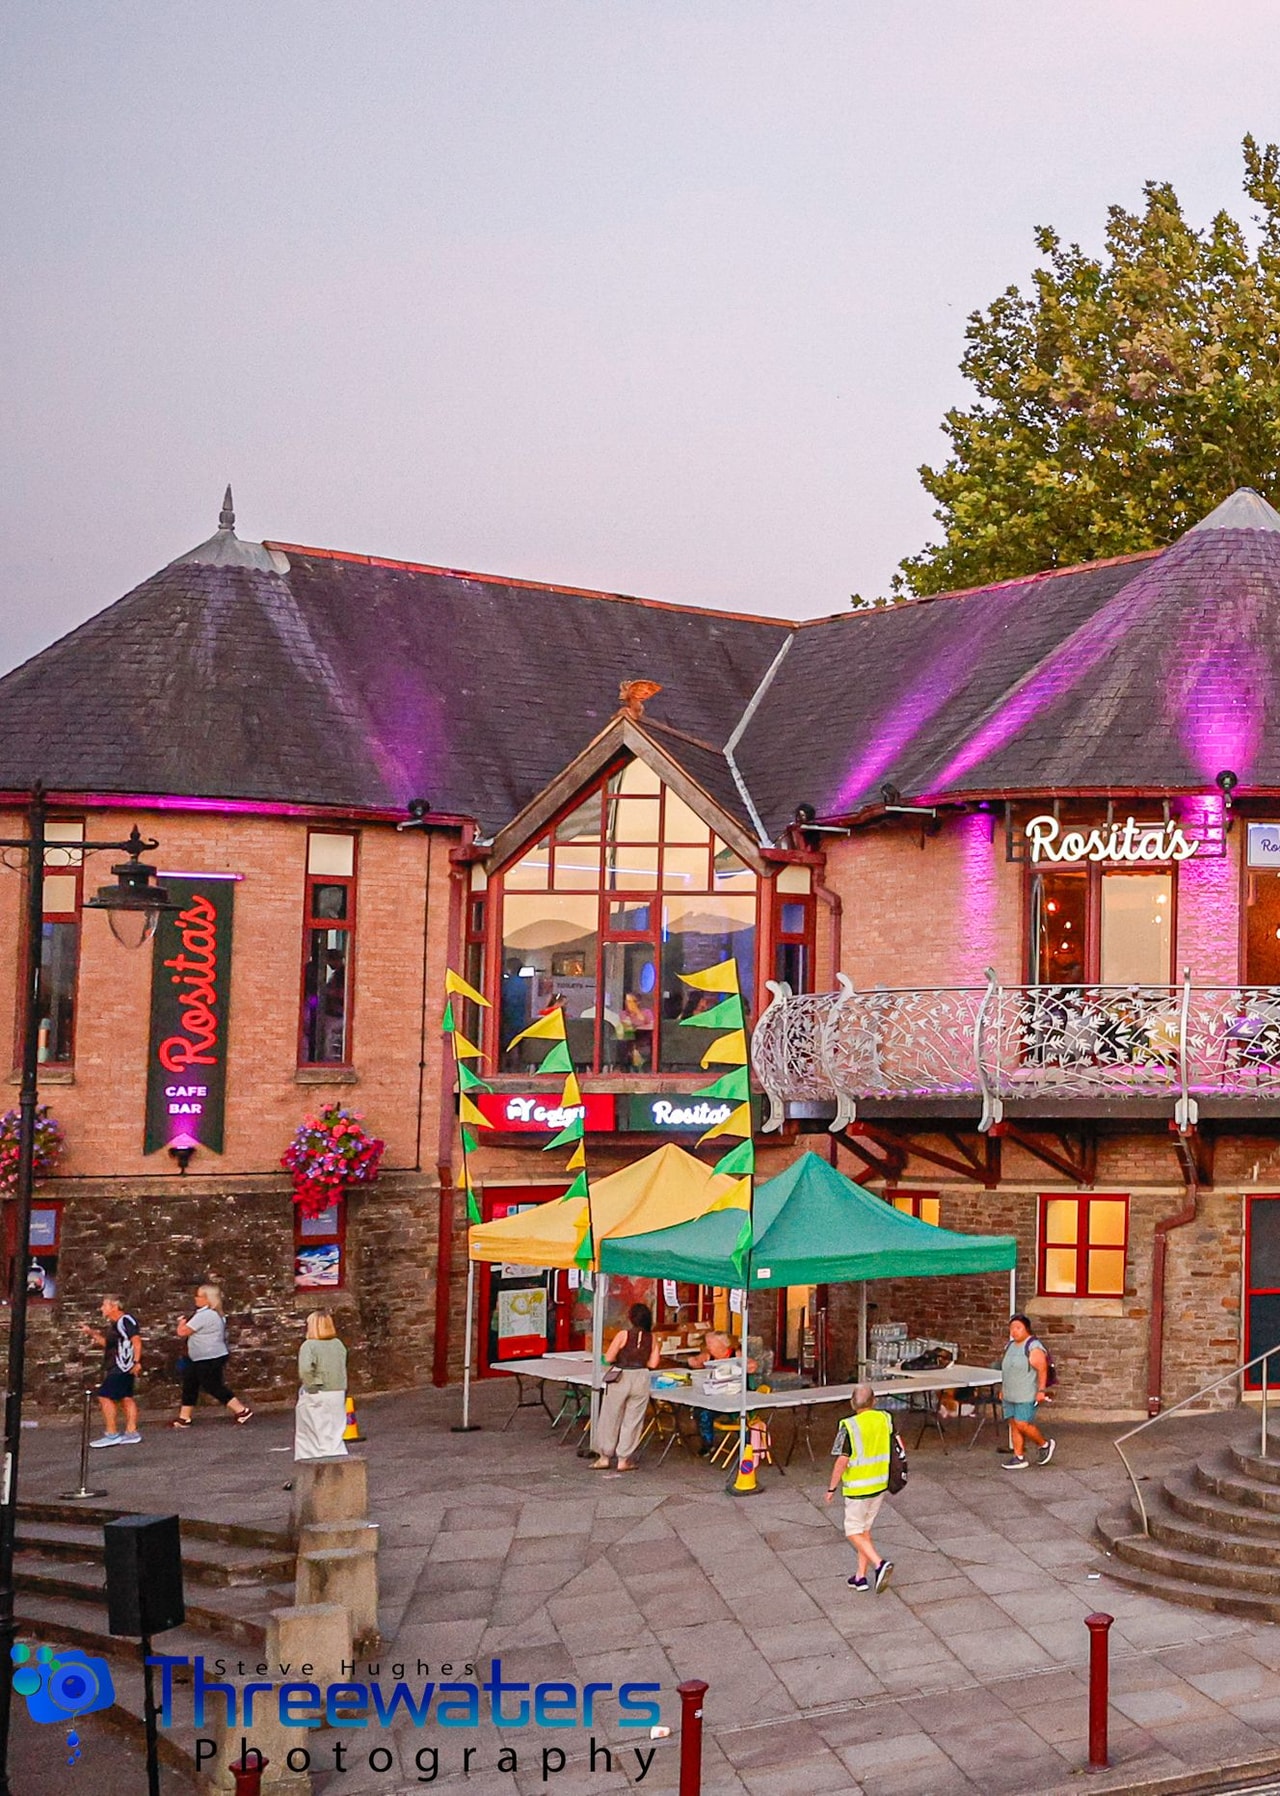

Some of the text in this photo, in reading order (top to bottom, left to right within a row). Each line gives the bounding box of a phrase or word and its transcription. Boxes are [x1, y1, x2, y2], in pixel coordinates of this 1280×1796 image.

[1026, 815, 1199, 863] Rosita's
[159, 894, 218, 1073] Rosita's
[165, 1086, 207, 1097] CAFE
[168, 1103, 202, 1114] BAR
